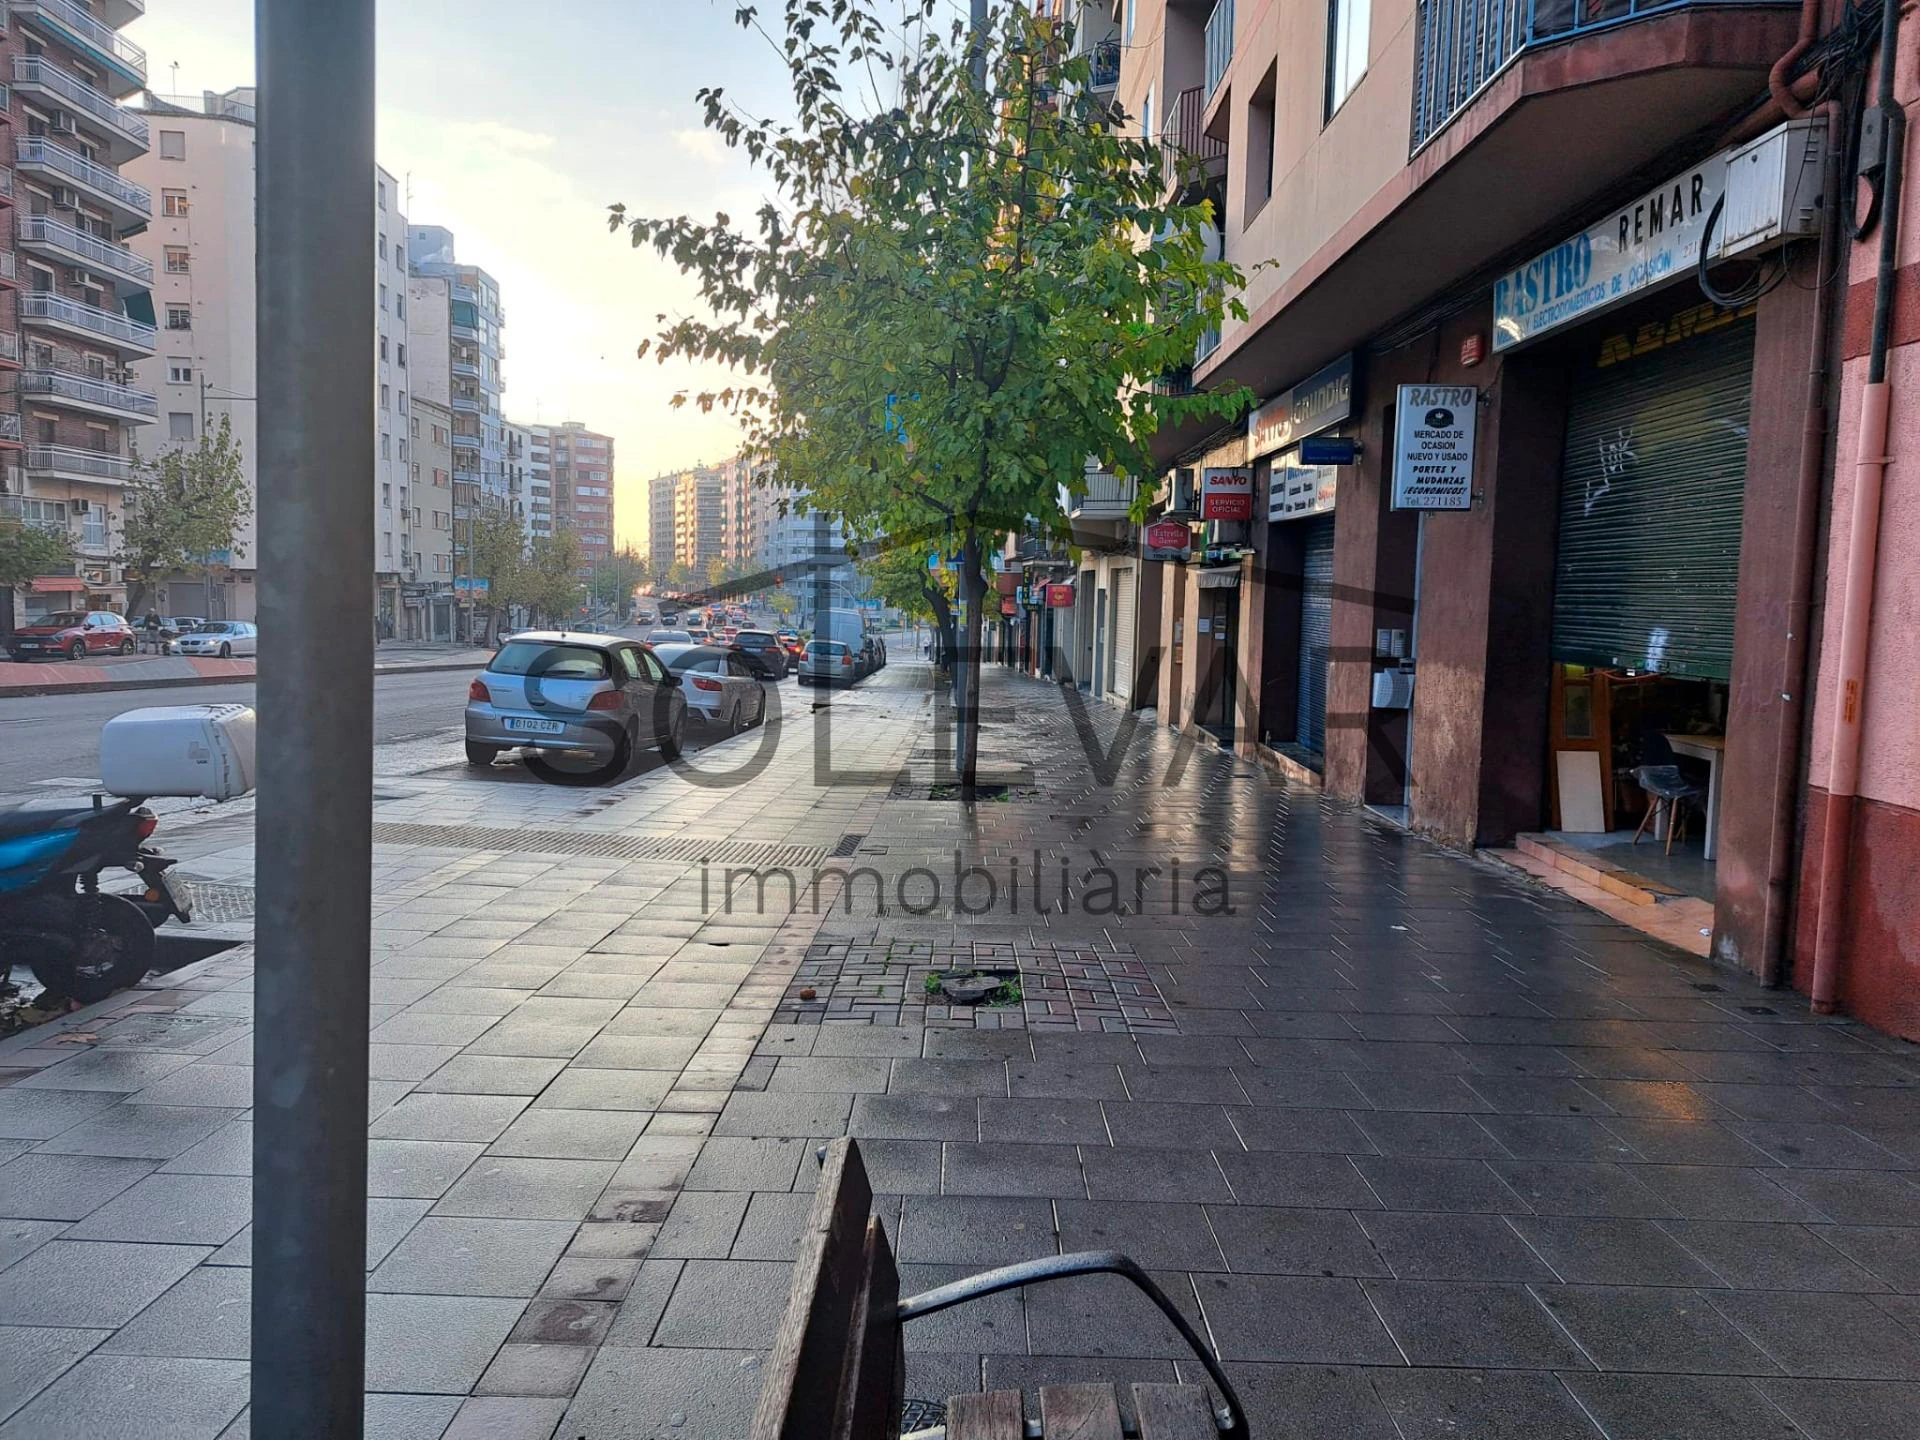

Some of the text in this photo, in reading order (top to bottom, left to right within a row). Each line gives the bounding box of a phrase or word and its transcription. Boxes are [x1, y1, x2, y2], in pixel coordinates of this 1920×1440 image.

[1618, 173, 1704, 254] REMAR
[1494, 231, 1593, 318] RASTRO
[1610, 272, 1622, 295] DE
[1628, 247, 1671, 287] OCASIÓN
[1294, 372, 1350, 425] GRUNDIG
[1410, 388, 1472, 407] RASTRO
[1414, 430, 1464, 439] MERCADO DE
[1421, 441, 1456, 450] OCASION
[1407, 452, 1468, 461] NUEVO Y USADO
[1412, 465, 1457, 474] PORTES Y
[1209, 476, 1247, 486] SANYO
[1416, 476, 1466, 485] MUDANZAS
[1423, 496, 1462, 506] 271185
[515, 719, 558, 730] 0102 CZR
